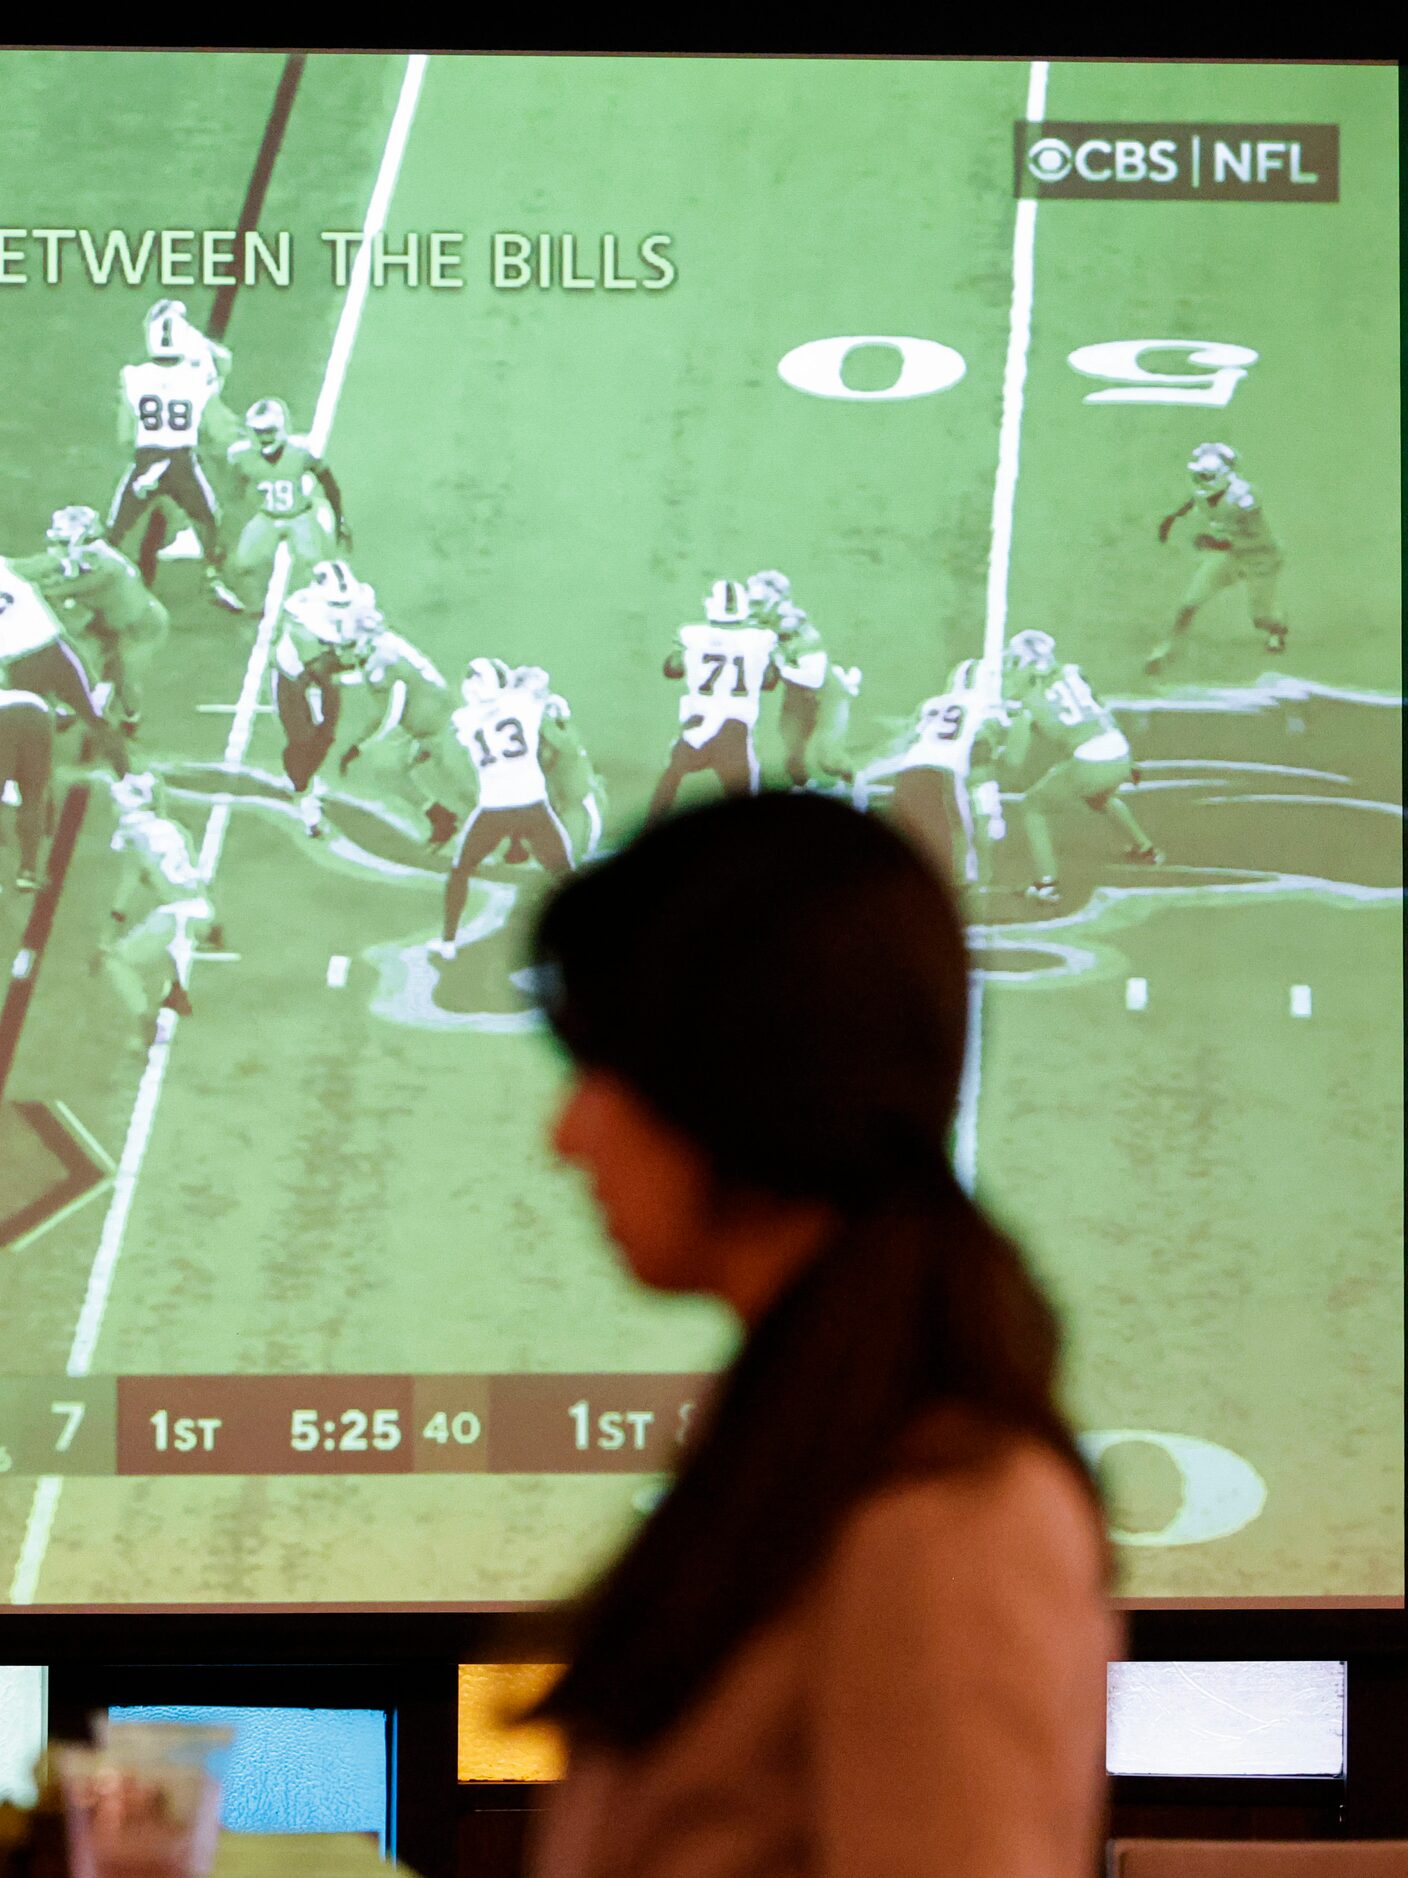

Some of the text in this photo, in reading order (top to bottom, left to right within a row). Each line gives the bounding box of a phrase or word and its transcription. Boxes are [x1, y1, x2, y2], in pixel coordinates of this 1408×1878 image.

[1074, 139, 1319, 184] CBS NFL
[321, 231, 465, 288] THE
[493, 232, 679, 290] BILLS
[138, 393, 193, 432] 88
[697, 652, 749, 697] 71
[473, 716, 529, 768] 13
[50, 1402, 86, 1453] 7
[148, 1408, 223, 1453] 1ST
[289, 1408, 403, 1453] 5:25
[422, 1410, 482, 1446] 40
[567, 1398, 655, 1451] 1ST
